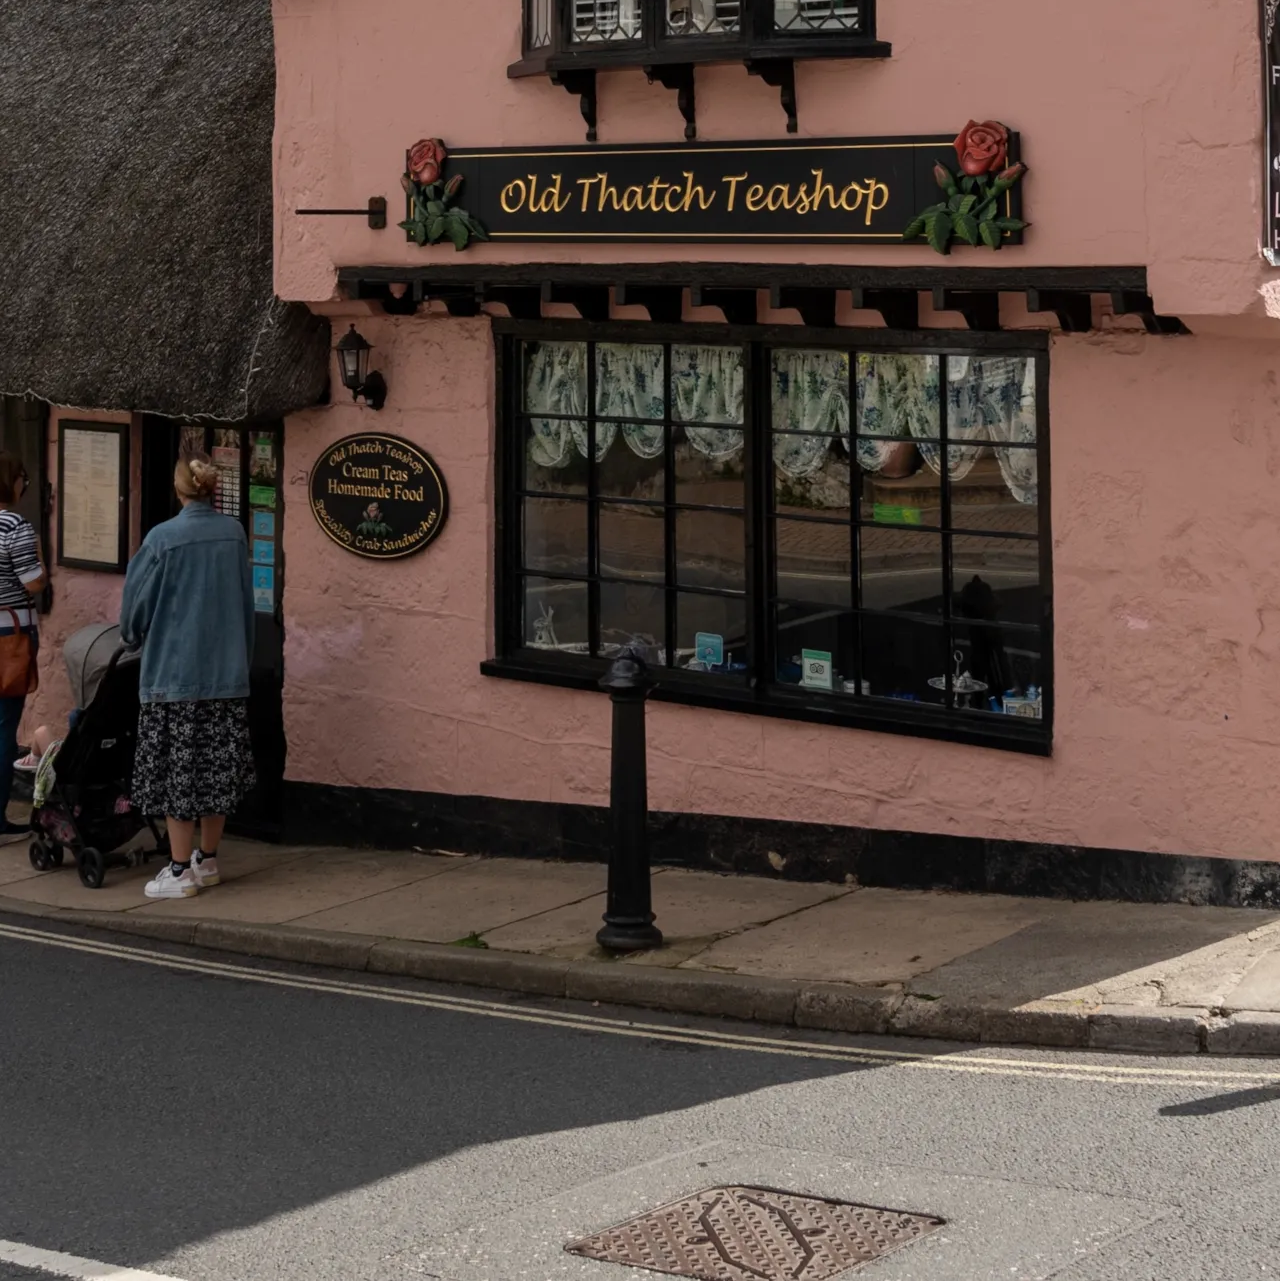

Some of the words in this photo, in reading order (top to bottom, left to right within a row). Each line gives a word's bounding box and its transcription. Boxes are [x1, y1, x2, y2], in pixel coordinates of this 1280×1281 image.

[500, 173, 571, 213] Old
[576, 170, 716, 213] Thatch
[721, 168, 889, 226] Teashop
[328, 447, 347, 467] Old
[347, 440, 384, 456] Thatch
[385, 444, 424, 475] Teashop
[342, 461, 379, 480] Cream
[381, 464, 409, 482] Teas
[327, 478, 391, 499] Homemade
[394, 484, 424, 502] Food
[315, 498, 354, 545] Speciality
[355, 535, 382, 551] Crab
[382, 507, 438, 552] Sandwiches
